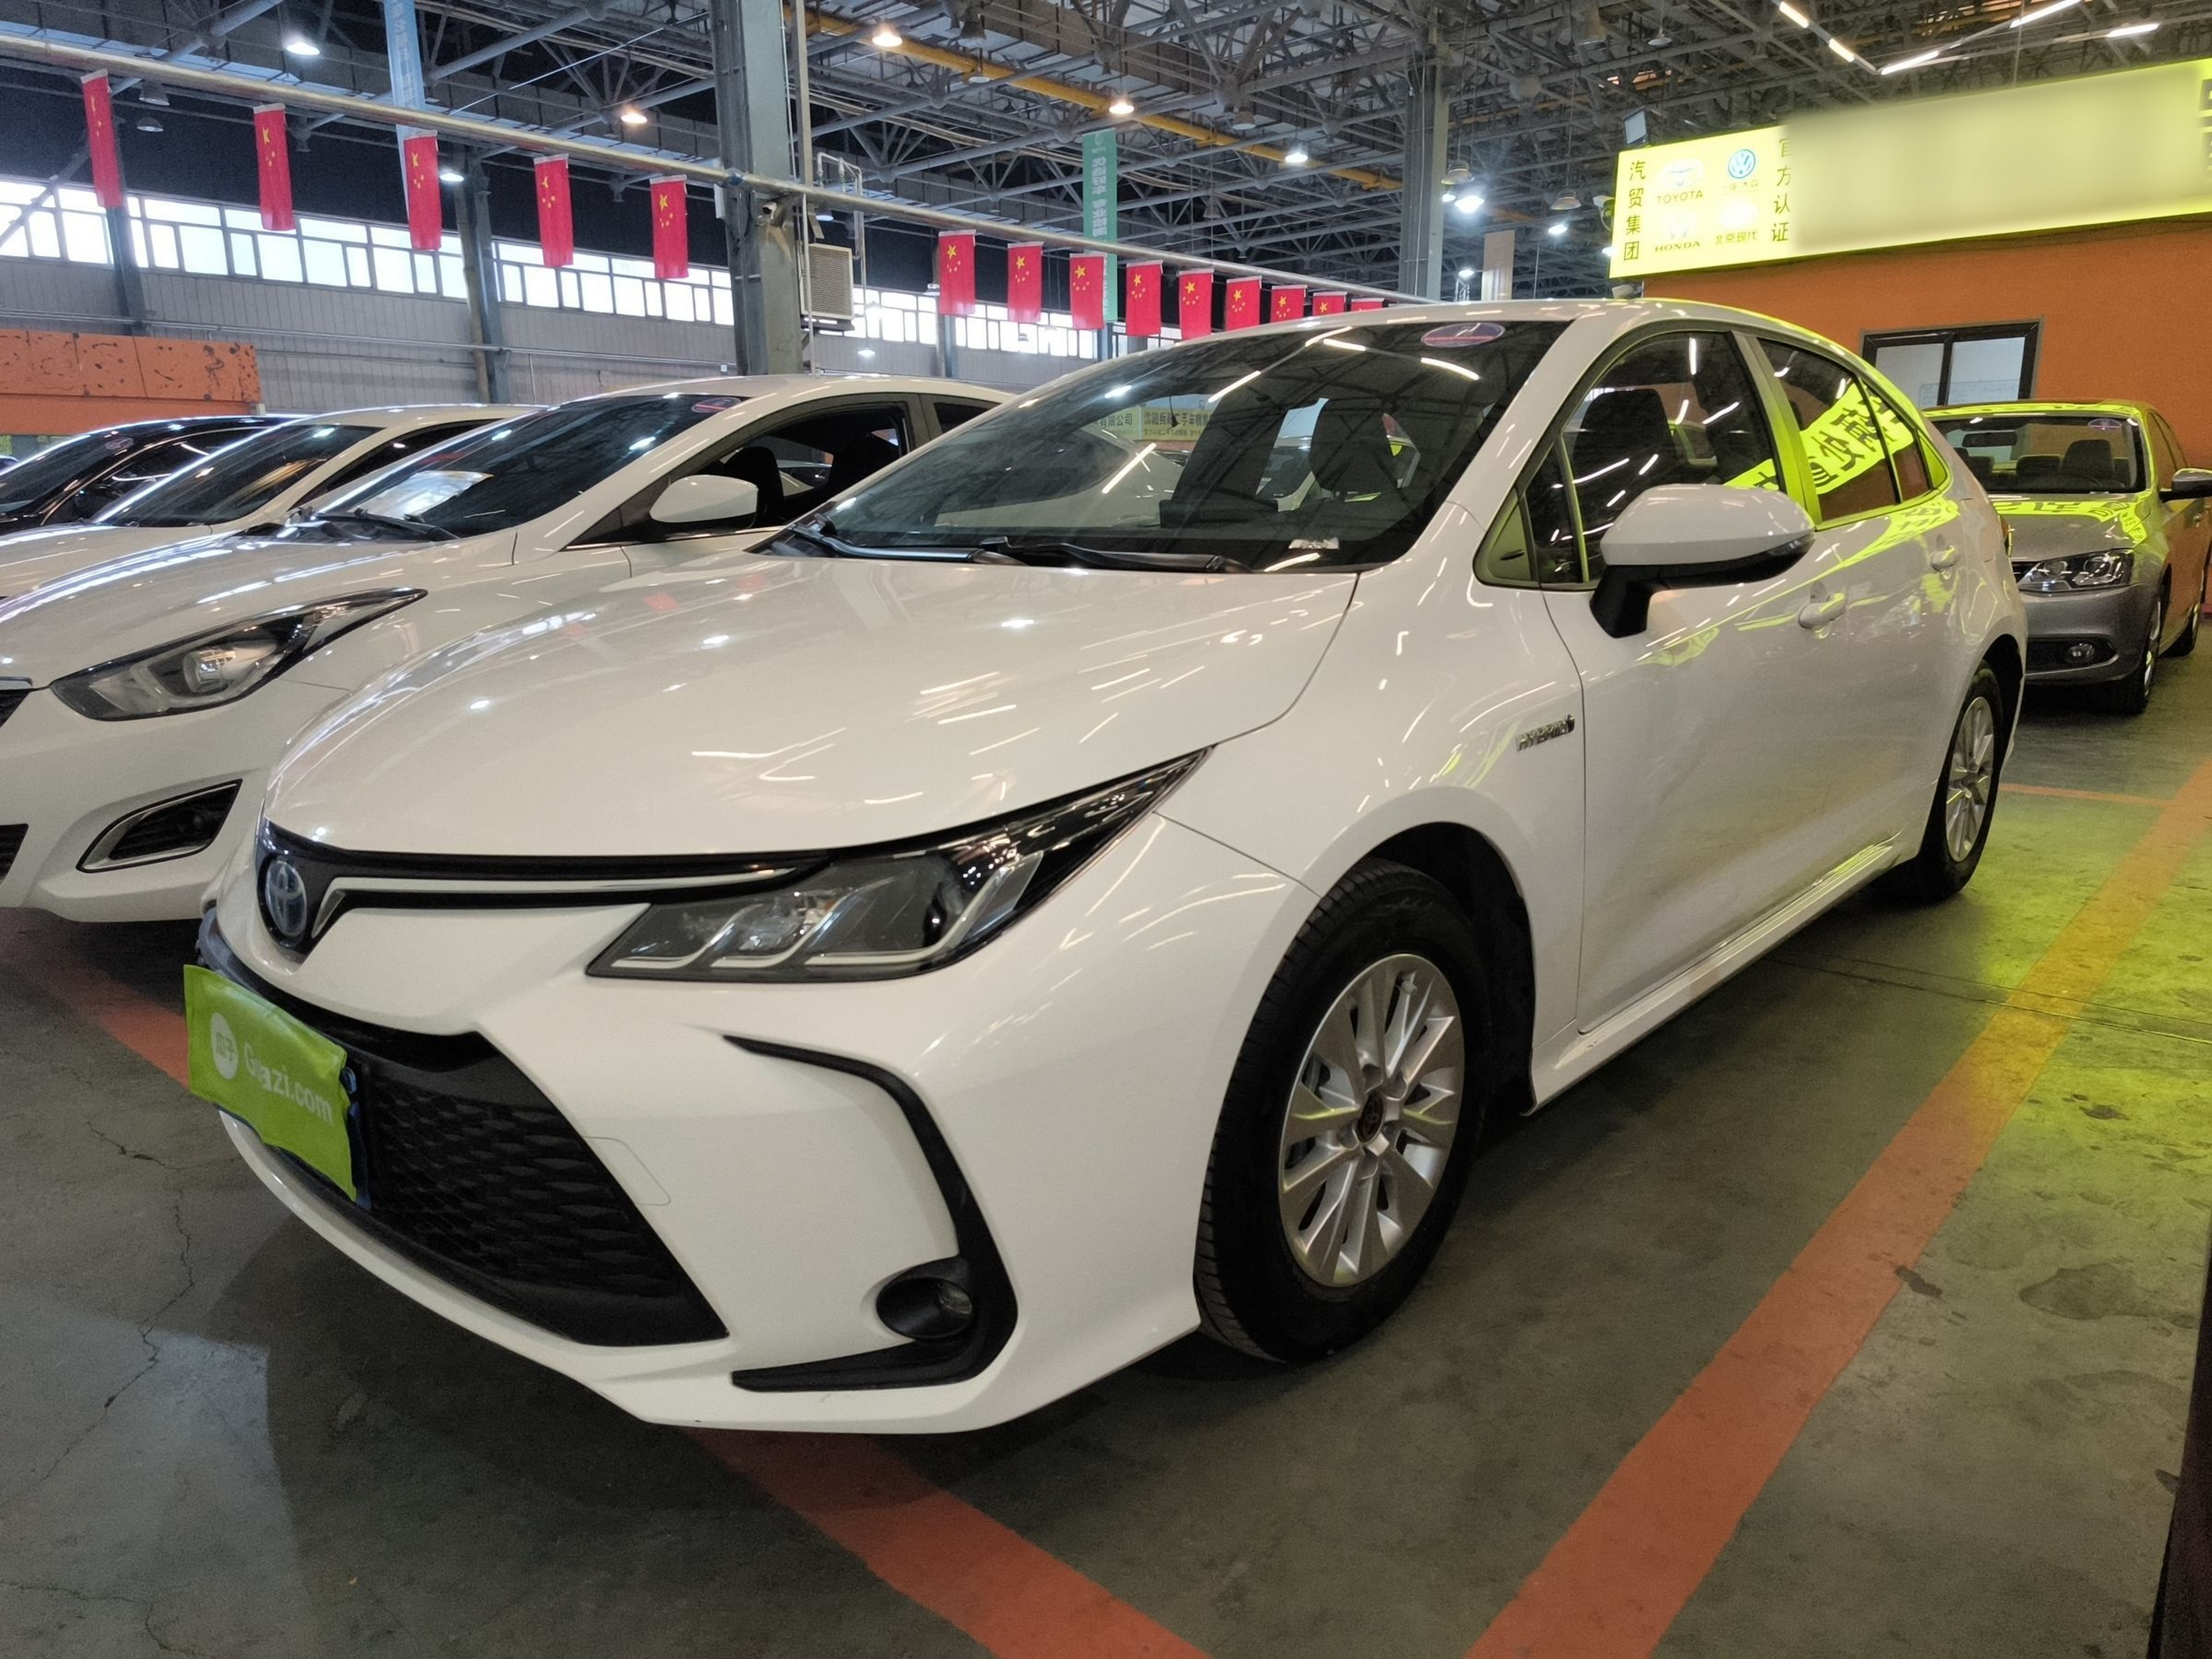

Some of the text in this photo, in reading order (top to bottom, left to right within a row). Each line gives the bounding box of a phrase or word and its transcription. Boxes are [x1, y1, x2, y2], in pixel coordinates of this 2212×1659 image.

[1657, 190, 1703, 204] TOYOTA
[1623, 160, 1646, 261] 汽贸集团
[1654, 240, 1701, 252] HONDA
